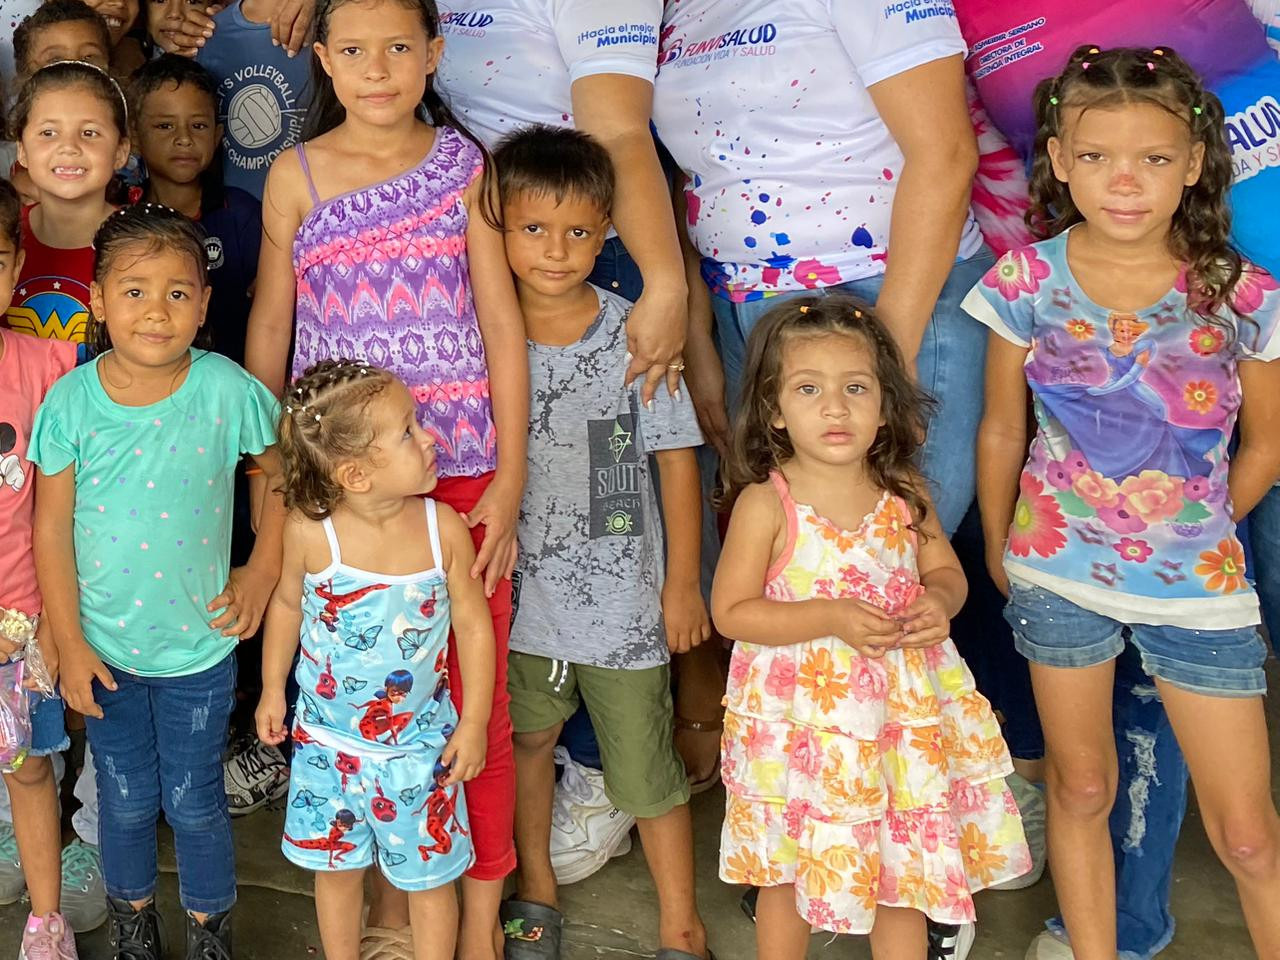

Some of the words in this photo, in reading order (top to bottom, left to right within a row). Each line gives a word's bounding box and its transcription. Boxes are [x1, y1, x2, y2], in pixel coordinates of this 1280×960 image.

[577, 24, 615, 45] ¡Hacia
[618, 23, 628, 33] el
[631, 23, 654, 34] mejor
[683, 23, 777, 58] FUNVISALUD
[1015, 39, 1025, 49] DE
[740, 45, 776, 57] SALUD
[1004, 43, 1042, 63] INTEGRAL
[234, 64, 296, 108] VOLLEYBALL
